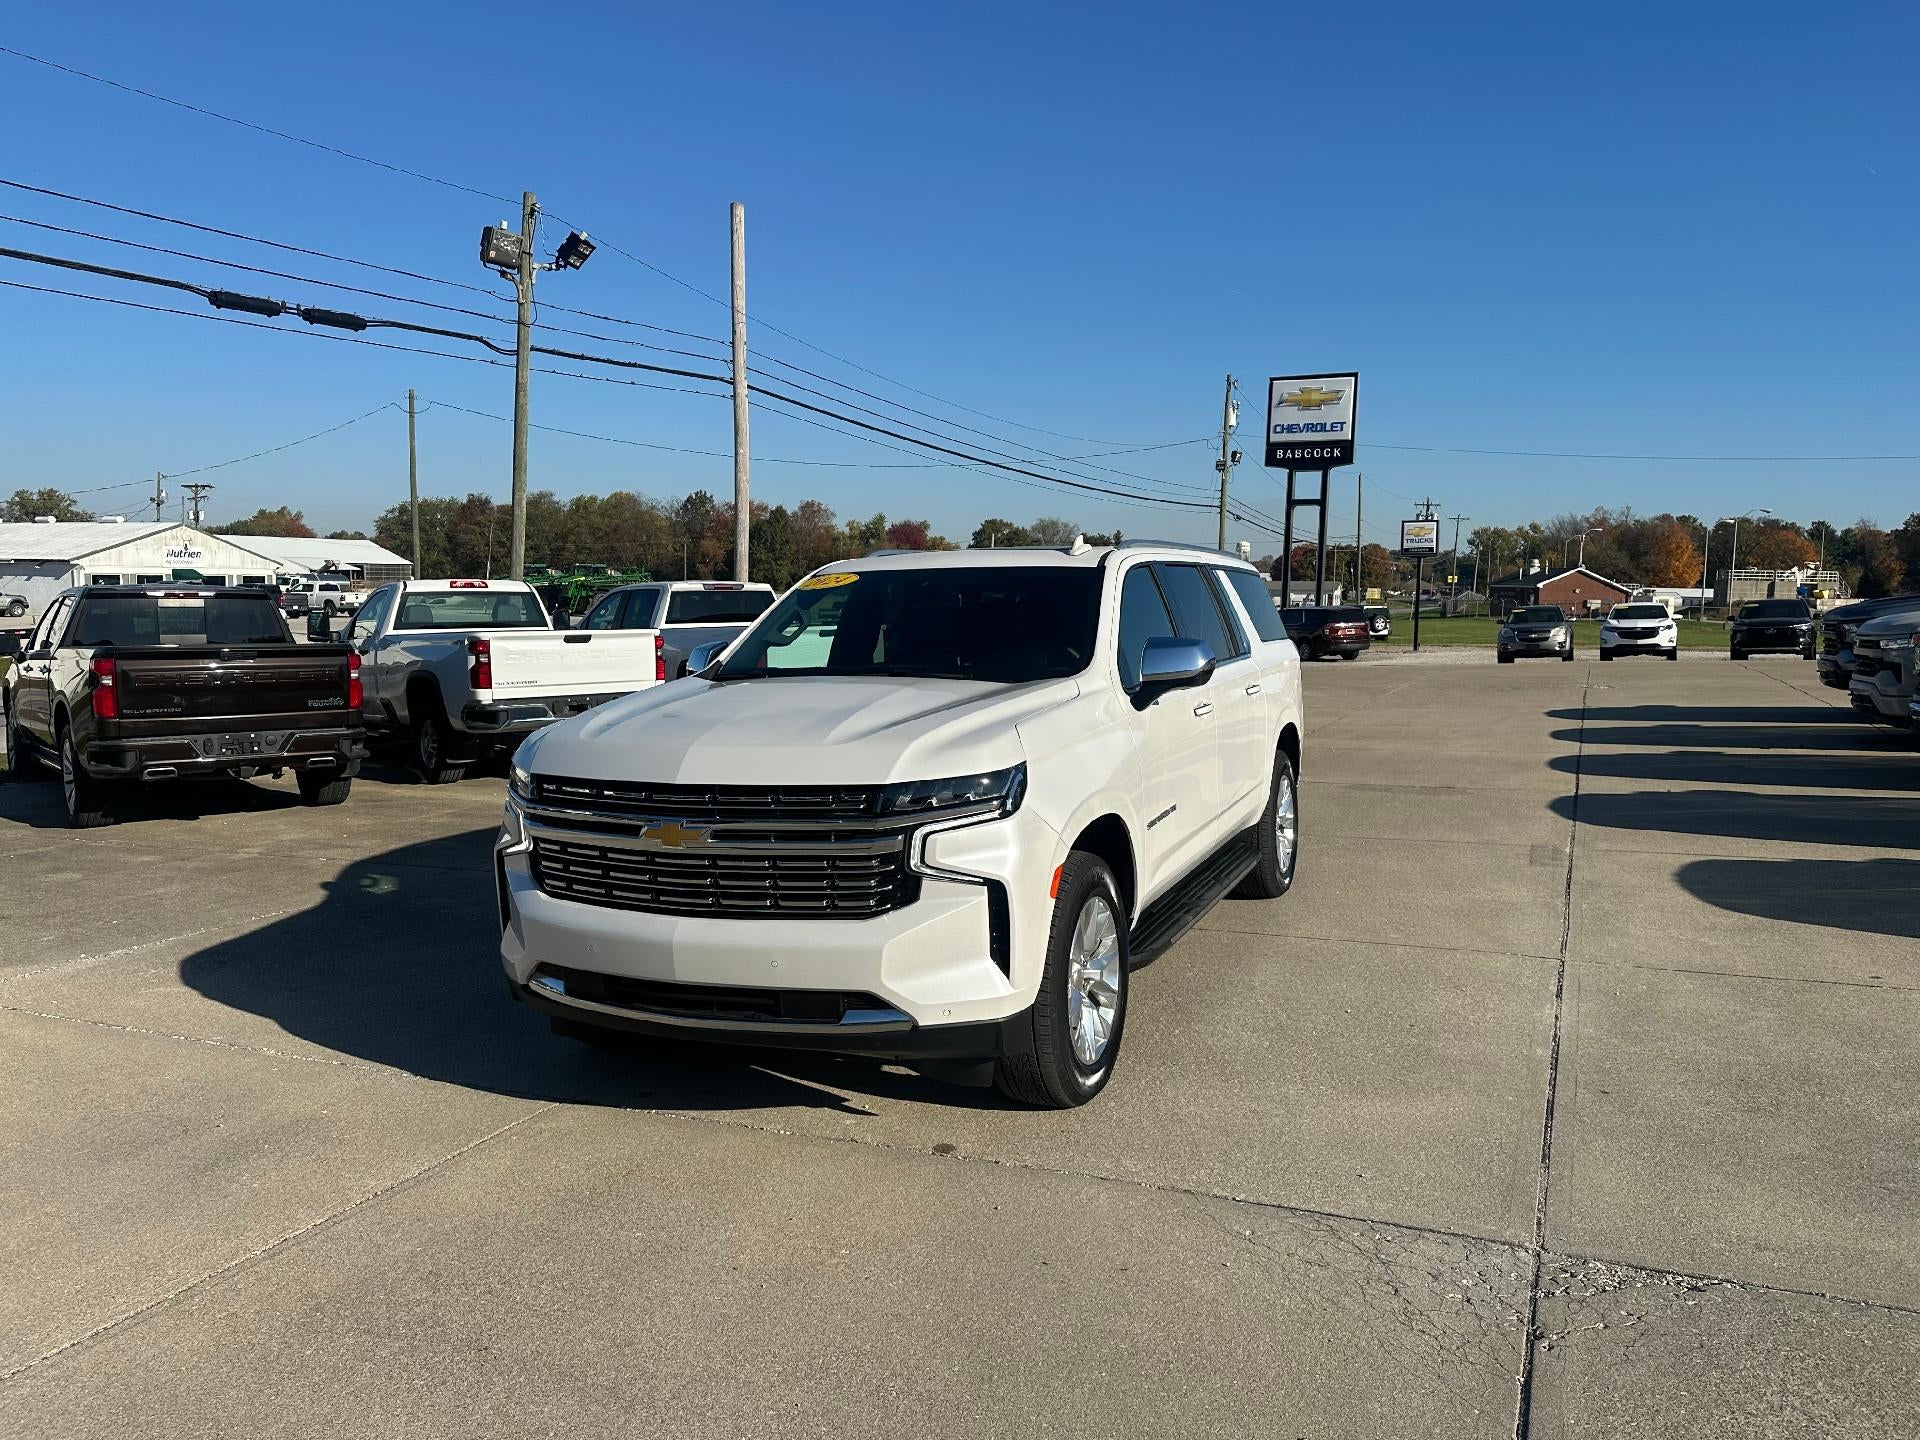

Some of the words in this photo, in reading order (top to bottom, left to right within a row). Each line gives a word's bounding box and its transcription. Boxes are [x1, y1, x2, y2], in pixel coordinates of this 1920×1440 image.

[1273, 422, 1346, 434] CHEVROLET
[1276, 448, 1341, 459] BABCOCK
[166, 549, 202, 558] Nutrien
